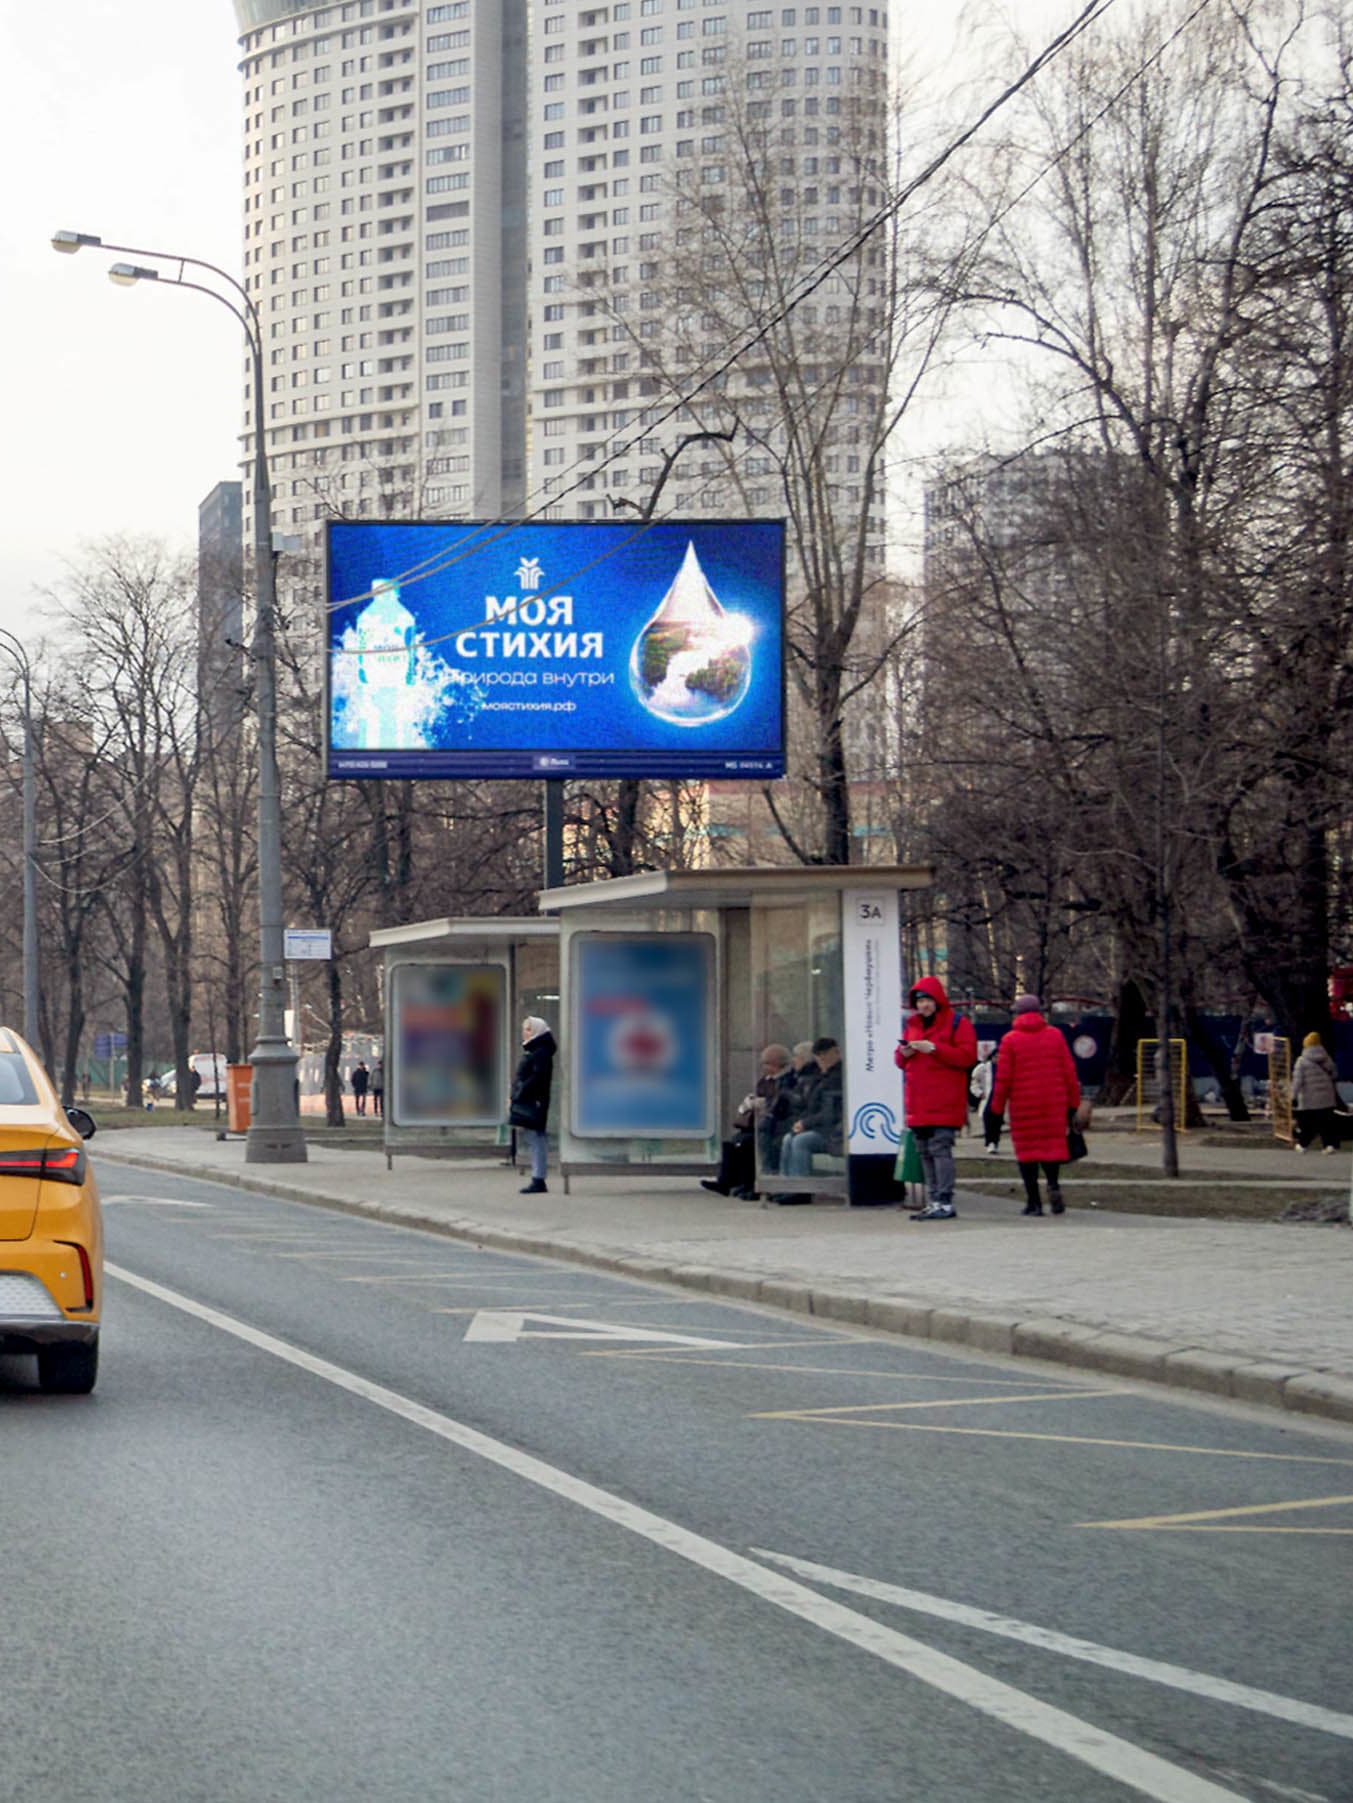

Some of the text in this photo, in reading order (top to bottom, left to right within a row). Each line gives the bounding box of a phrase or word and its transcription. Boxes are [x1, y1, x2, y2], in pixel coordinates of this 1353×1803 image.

[485, 596, 574, 626] МОЯ
[455, 632, 604, 659] СТИХИЯ
[542, 671, 615, 687] внутри
